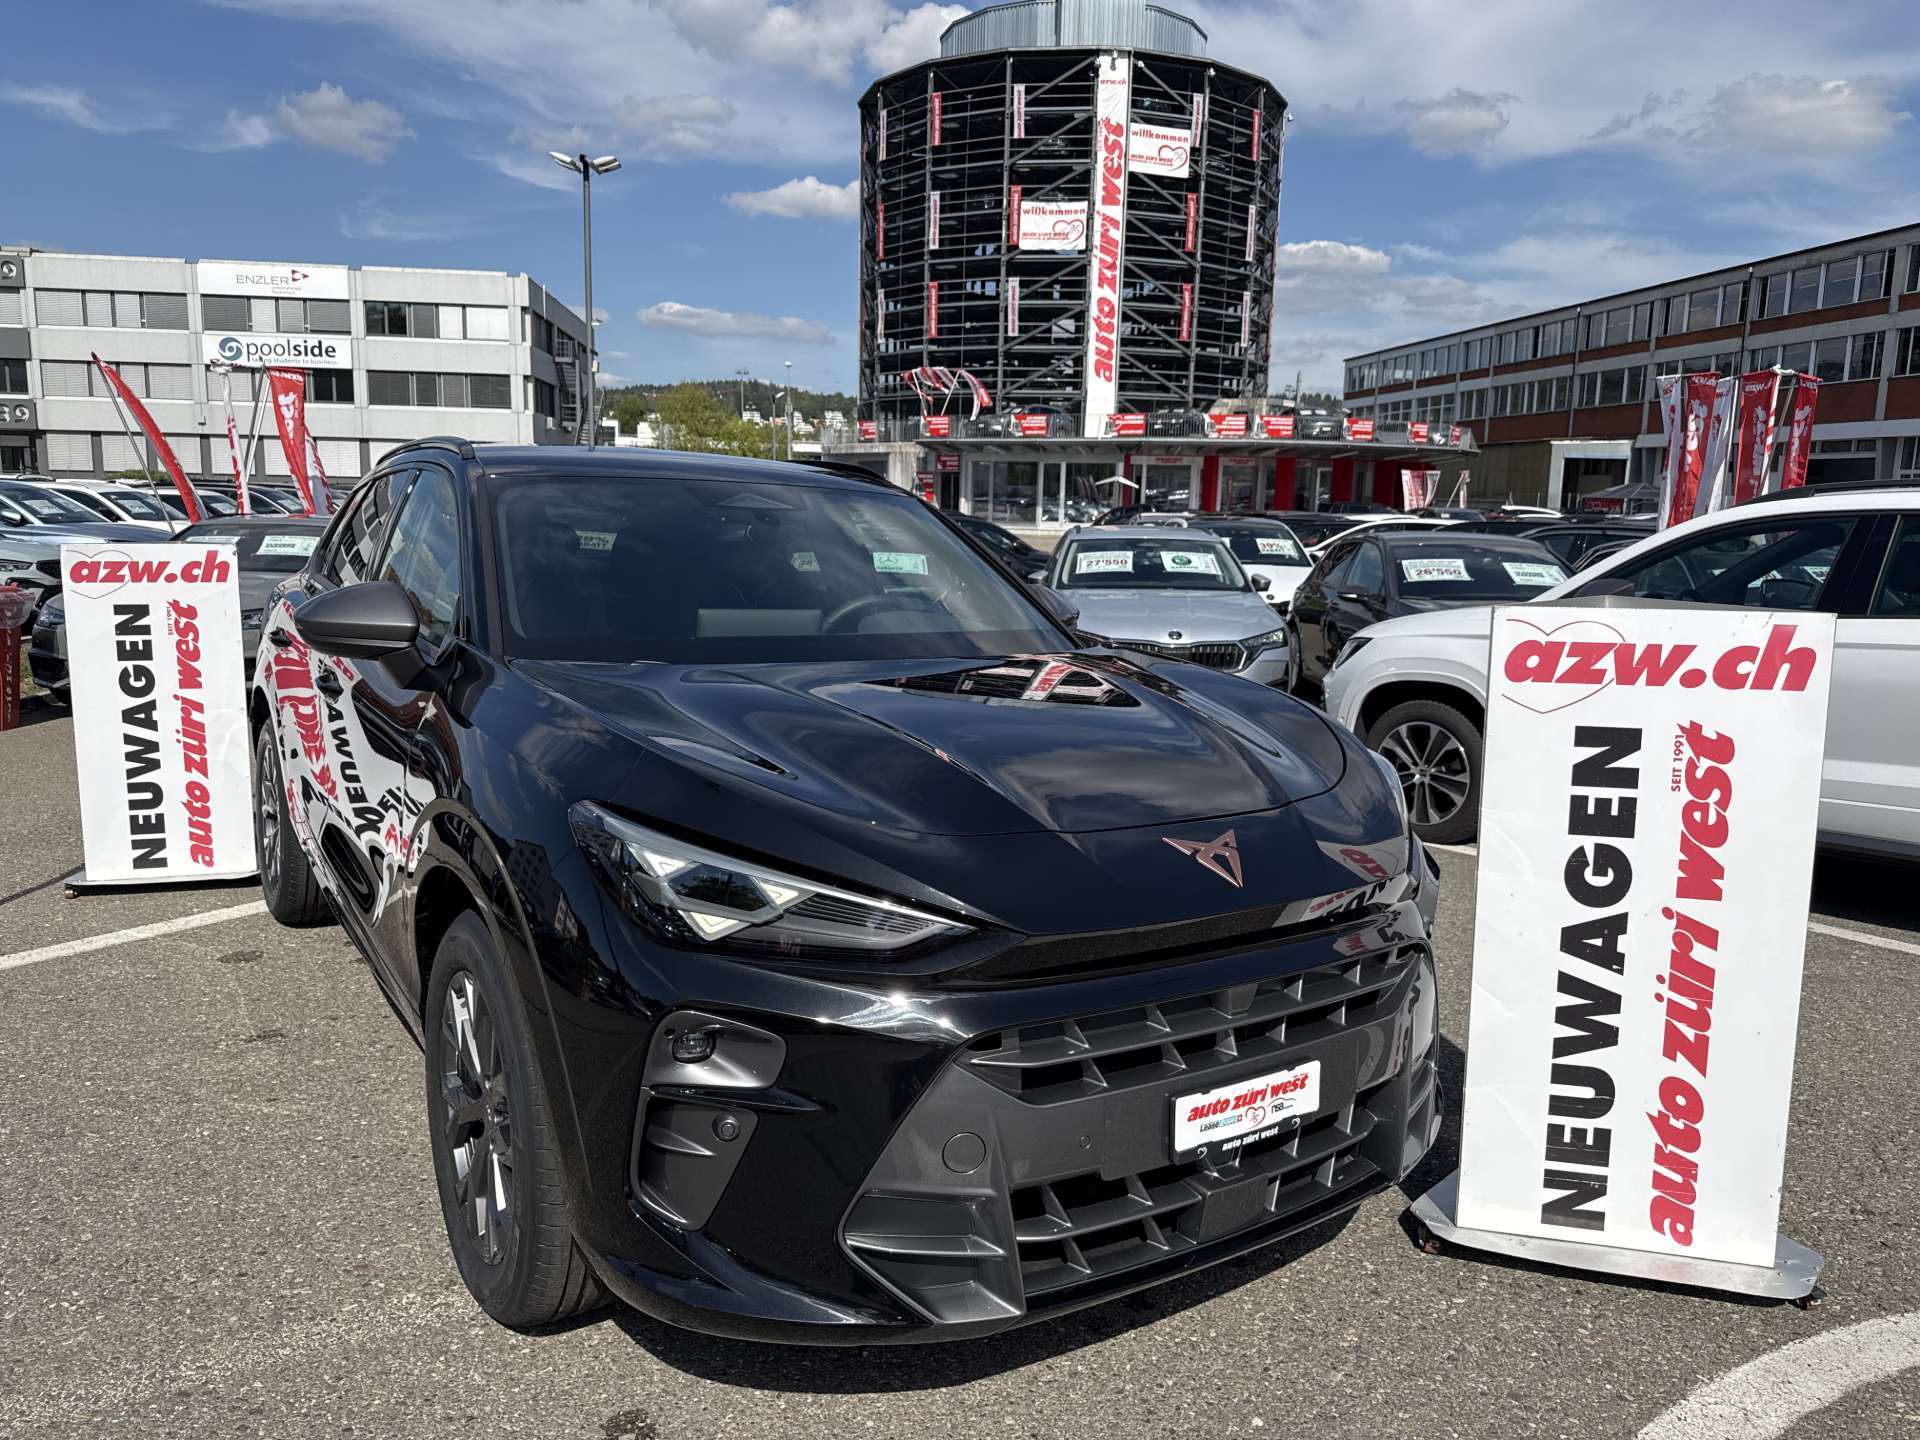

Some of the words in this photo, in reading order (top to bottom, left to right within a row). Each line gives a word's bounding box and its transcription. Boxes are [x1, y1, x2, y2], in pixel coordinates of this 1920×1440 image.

[1101, 116, 1124, 206] west
[1131, 129, 1189, 143] willkommen
[1022, 206, 1086, 216] willkommen
[1093, 210, 1121, 295] züri
[236, 274, 289, 285] ENZLER
[246, 339, 337, 362] poolside
[1092, 296, 1116, 383] auto
[69, 550, 230, 584] azw.ch
[166, 598, 203, 690] west
[1503, 623, 1817, 692] azw.ch
[113, 603, 169, 869] NEUWAGEN
[173, 693, 209, 779] züri
[1673, 734, 1685, 762] 1991
[1671, 767, 1682, 792] SEIT
[1675, 720, 1735, 901] west
[180, 779, 215, 868] auto
[1540, 725, 1643, 1232] NEUWAGEN
[1653, 906, 1720, 1079] züri
[1187, 1098, 1231, 1122] auto
[1231, 1084, 1270, 1110] züri
[1270, 1072, 1309, 1099] west
[1222, 1138, 1242, 1151] auto
[1242, 1131, 1260, 1145] züri
[1260, 1126, 1279, 1139] west
[1645, 1076, 1705, 1247] auto
